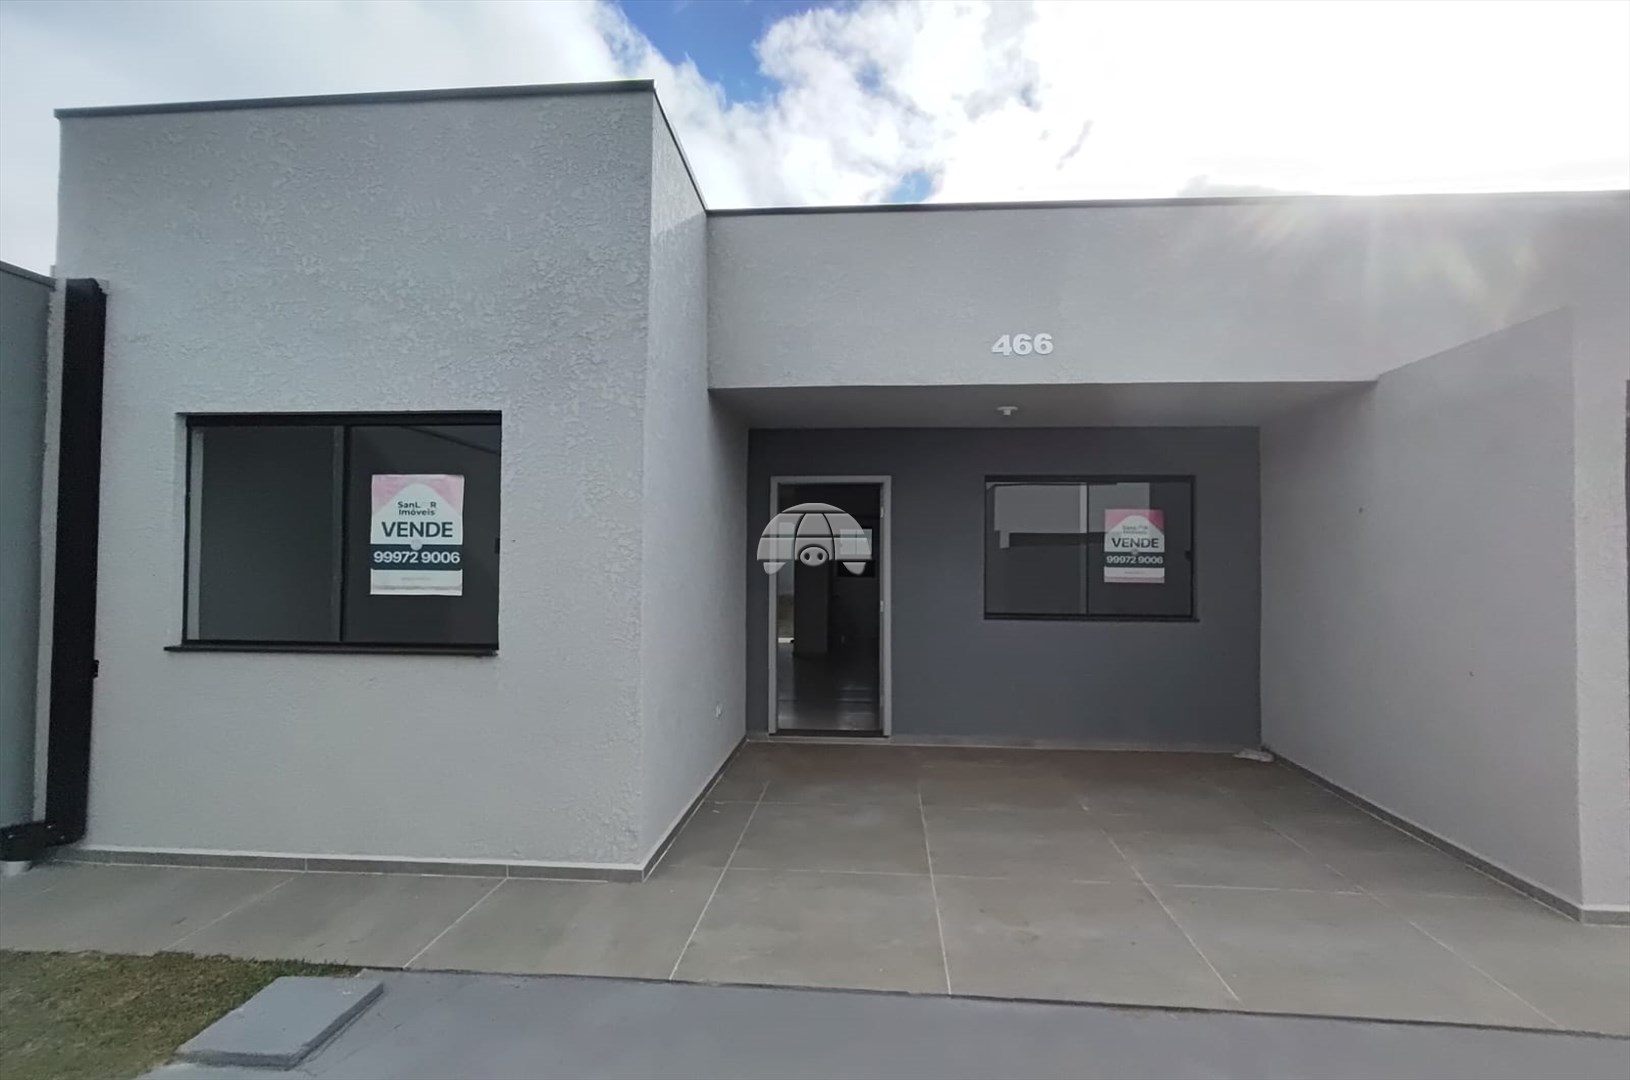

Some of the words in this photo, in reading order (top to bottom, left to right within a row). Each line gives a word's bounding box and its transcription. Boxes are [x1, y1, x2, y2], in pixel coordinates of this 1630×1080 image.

[991, 333, 1054, 356] 466
[398, 508, 436, 516] Imóveis
[381, 521, 453, 538] VENDE
[1111, 537, 1160, 549] VENDE
[373, 551, 419, 563] 99972
[421, 551, 461, 564] 9006
[1106, 555, 1137, 564] 99972
[1138, 556, 1164, 564] 9006
